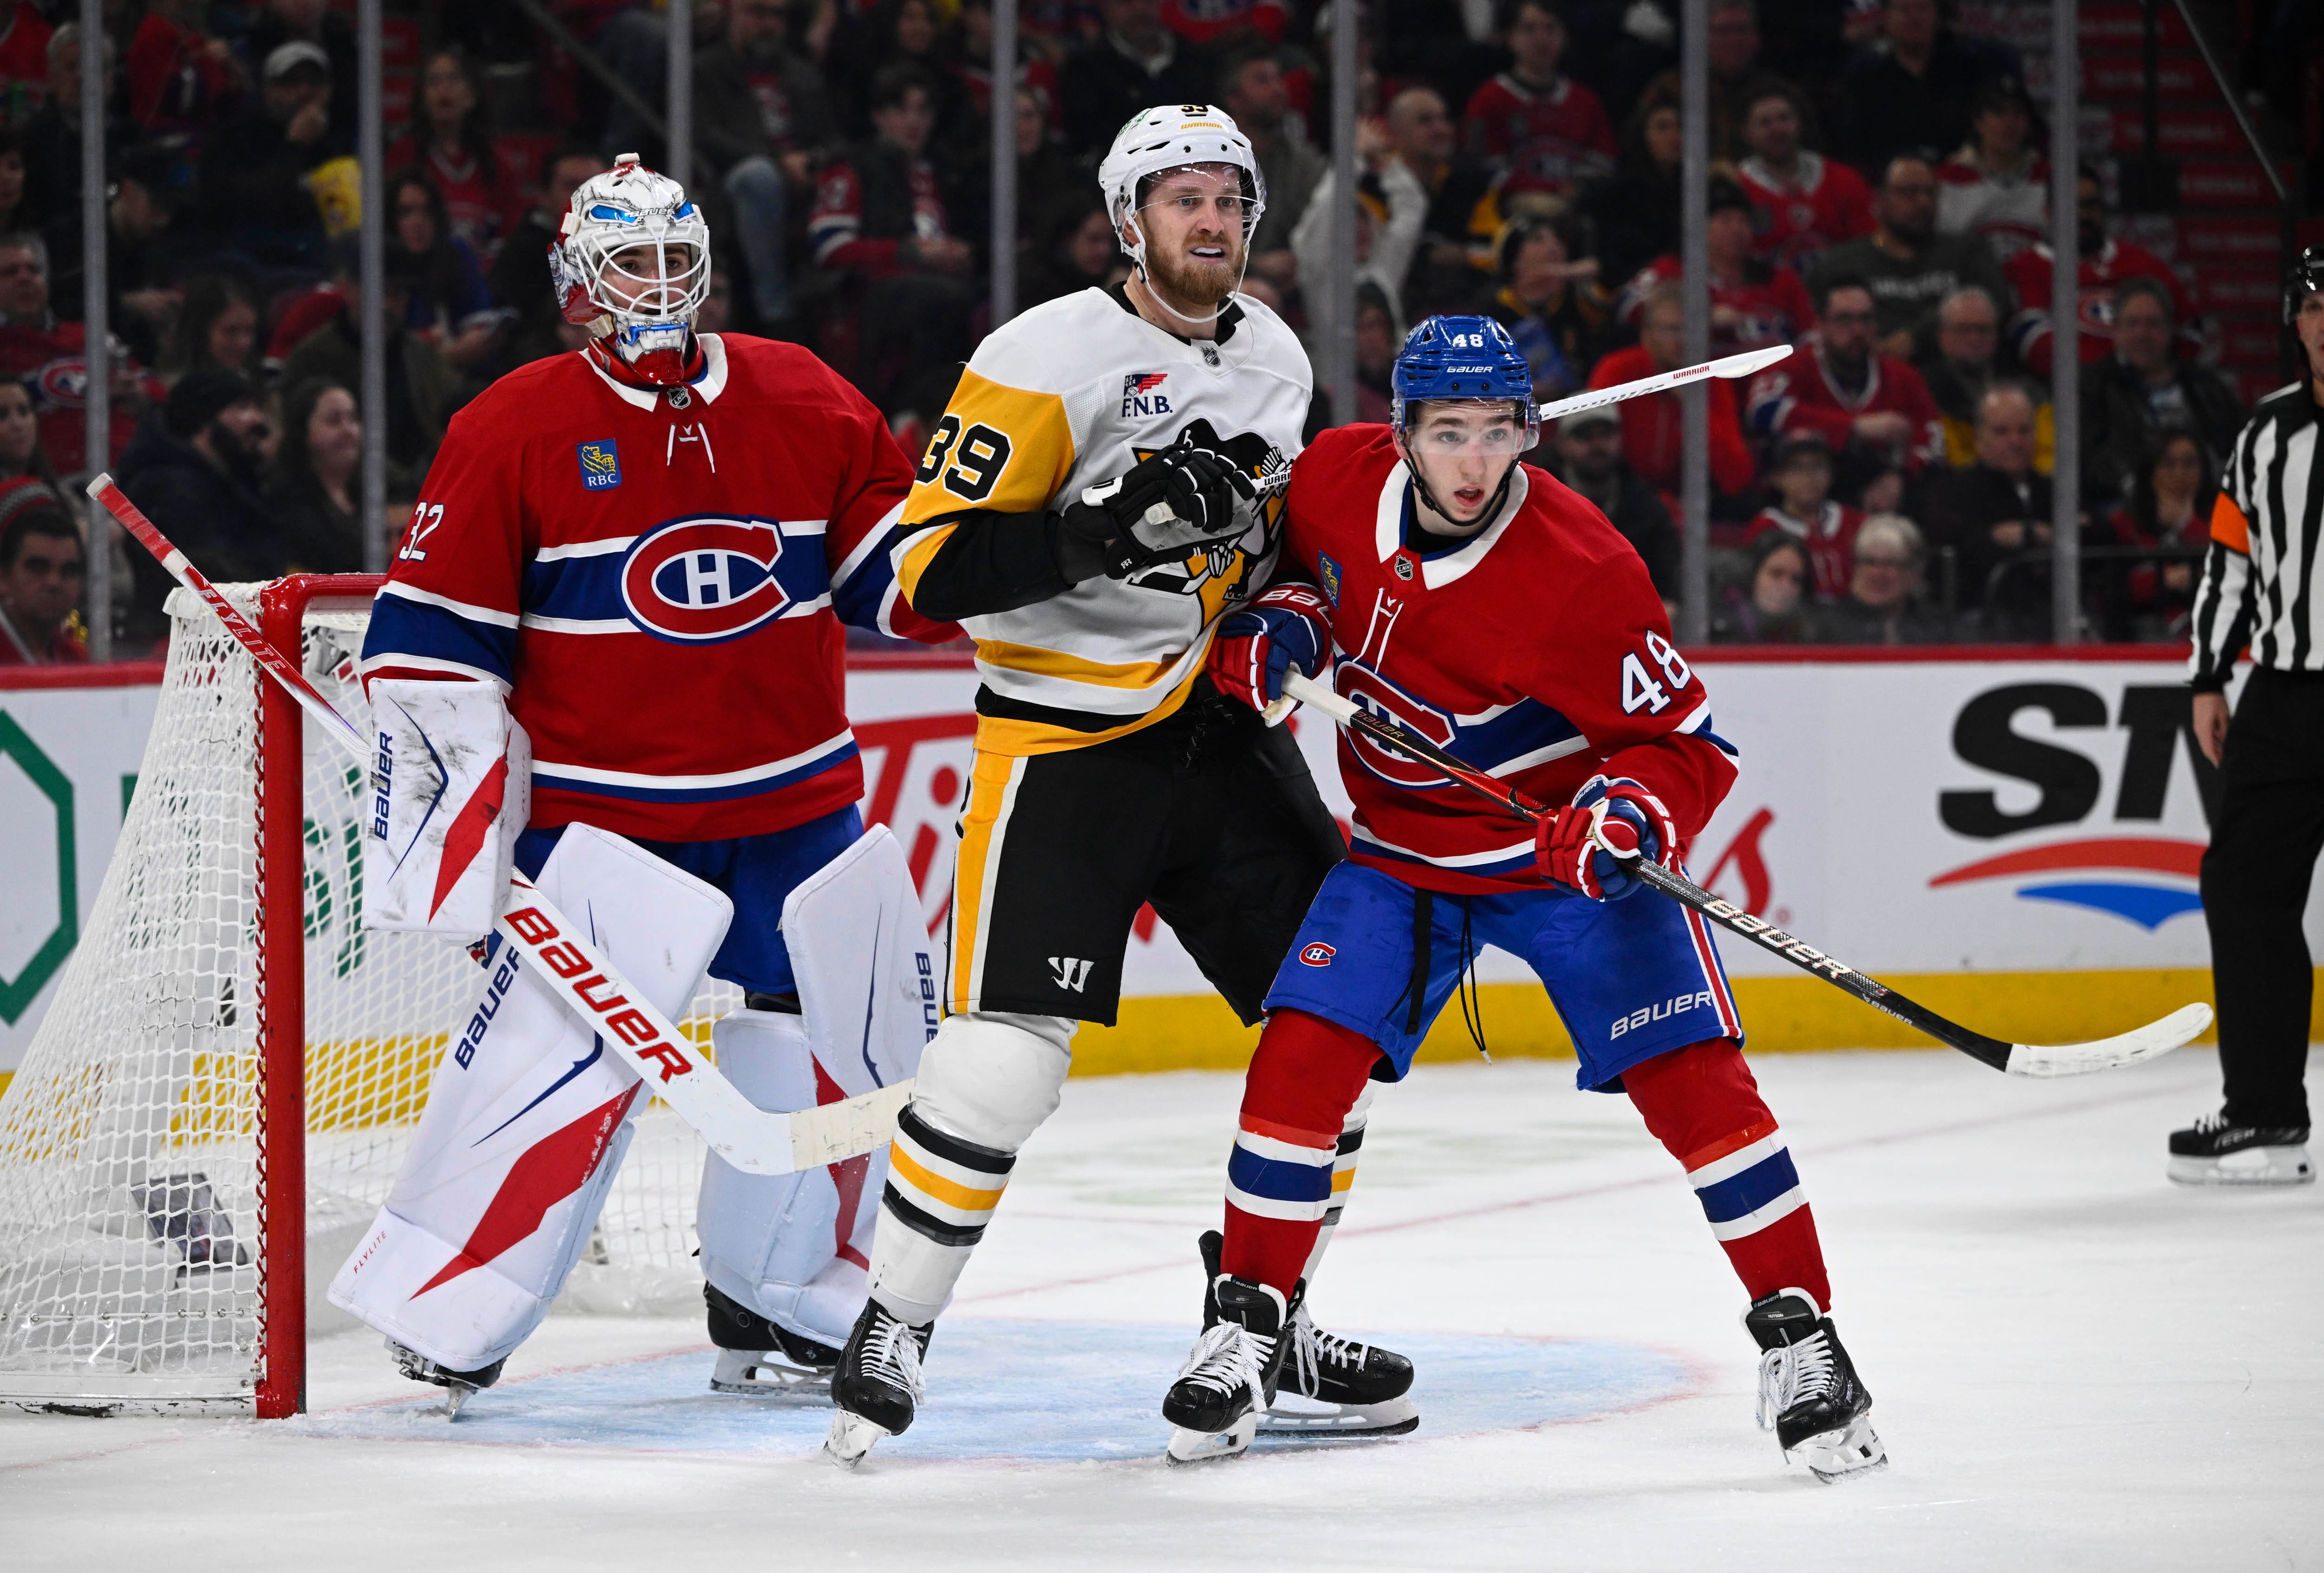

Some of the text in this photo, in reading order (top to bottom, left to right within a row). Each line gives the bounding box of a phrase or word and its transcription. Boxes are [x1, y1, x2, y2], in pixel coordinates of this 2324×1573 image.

[1206, 352, 1215, 363] NHL
[1452, 334, 1484, 348] 48
[1673, 365, 1710, 379] WARRIOR
[673, 390, 686, 405] LNH
[1122, 395, 1173, 417] F.N.B.
[915, 413, 1014, 504] 39
[588, 474, 617, 487] RBC
[399, 501, 445, 561] 32
[198, 589, 286, 670] FLYLITE
[1621, 630, 1691, 715] 48
[1354, 711, 1406, 738] BAUER
[374, 731, 393, 841] BAUER
[1703, 900, 1855, 979] BAUER
[455, 946, 520, 1071] BAUER
[502, 905, 694, 1084] BAUER
[915, 952, 938, 1044] BAUE
[1610, 990, 1712, 1041] BAUER
[1871, 1000, 1913, 1026] BAUER
[354, 1231, 386, 1274] FLYLITE
[1235, 1281, 1257, 1290] BAUER
[1757, 1294, 1780, 1307] BAUER
